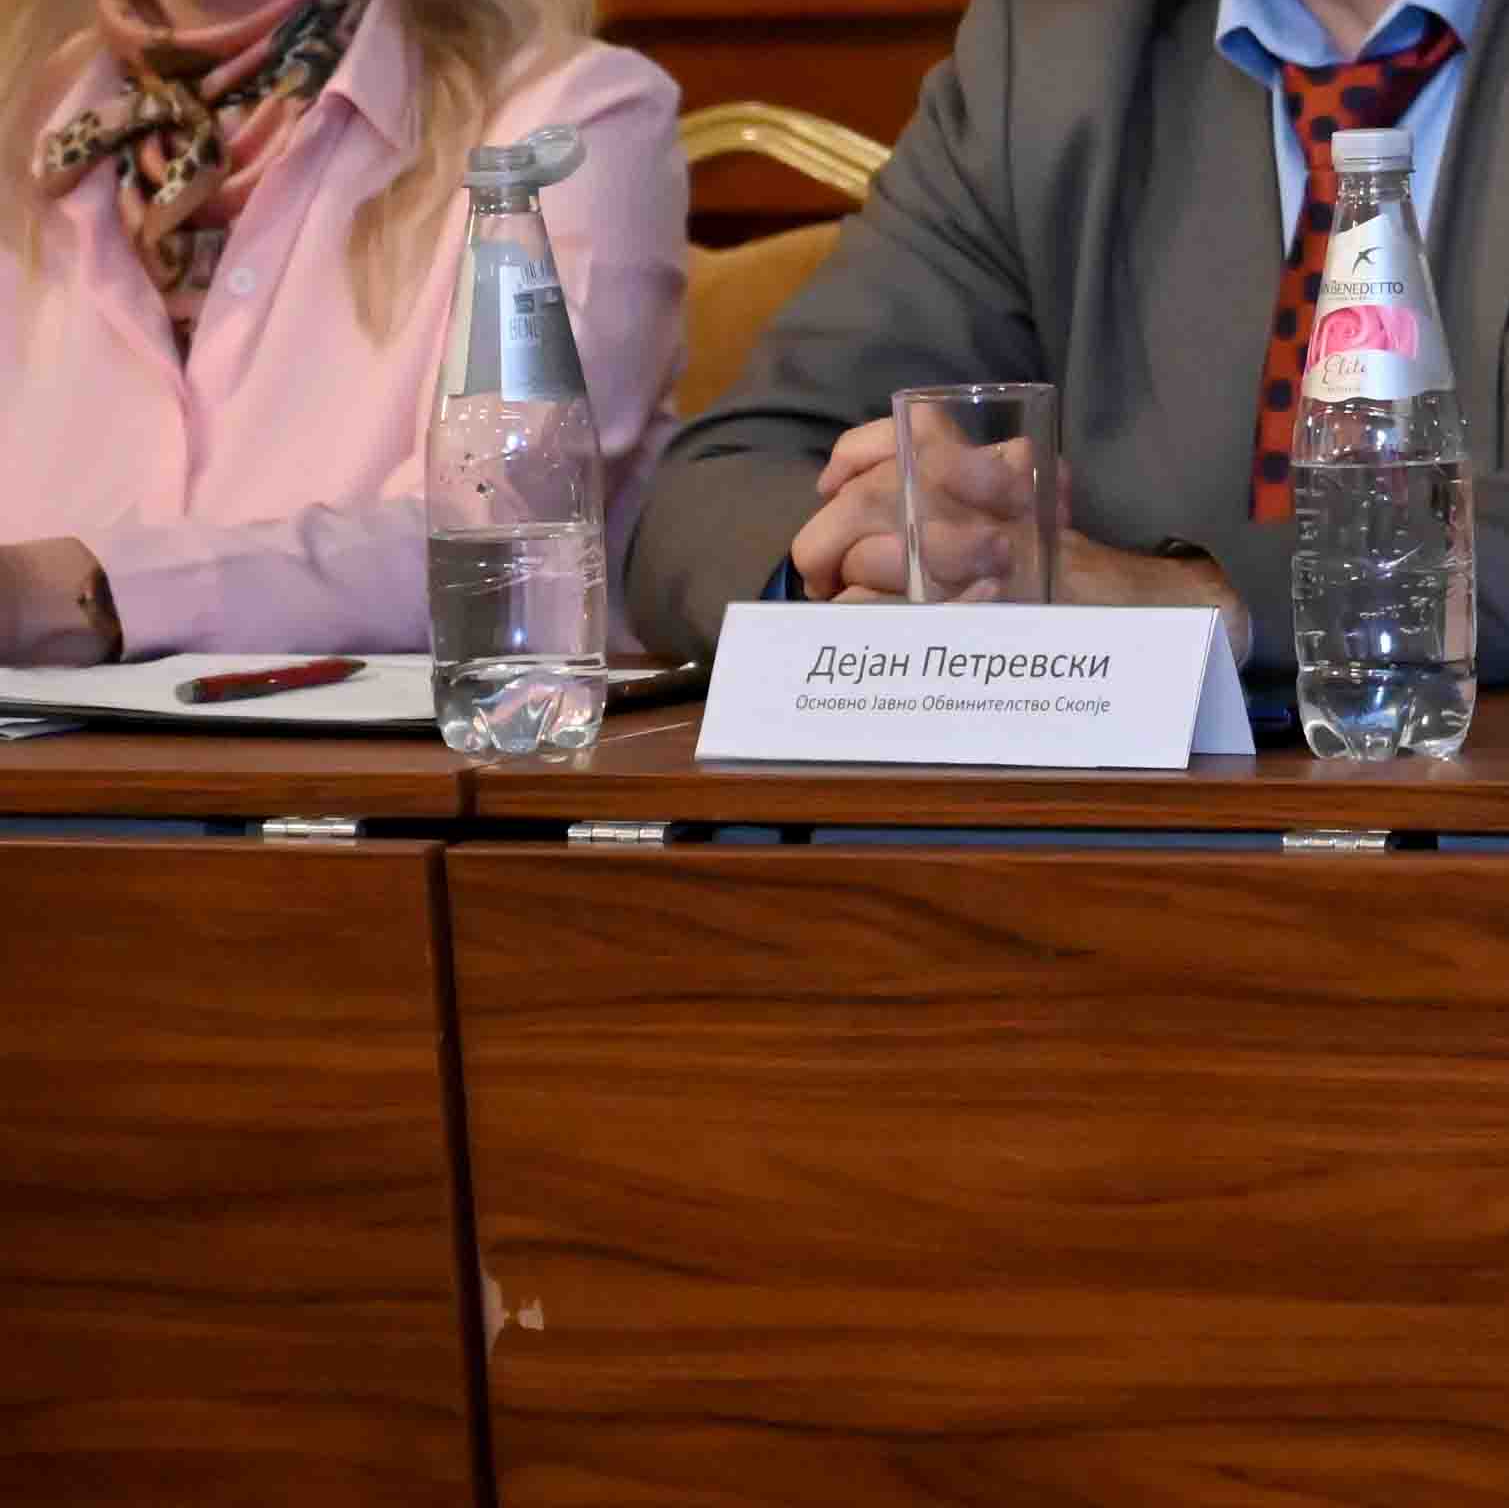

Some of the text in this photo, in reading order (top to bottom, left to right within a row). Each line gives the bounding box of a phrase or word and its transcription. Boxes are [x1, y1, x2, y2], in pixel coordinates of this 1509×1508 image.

[806, 646, 1110, 684] Дејан Петревски
[795, 694, 1111, 716] Основно Јавно Обвинителство Скопје
